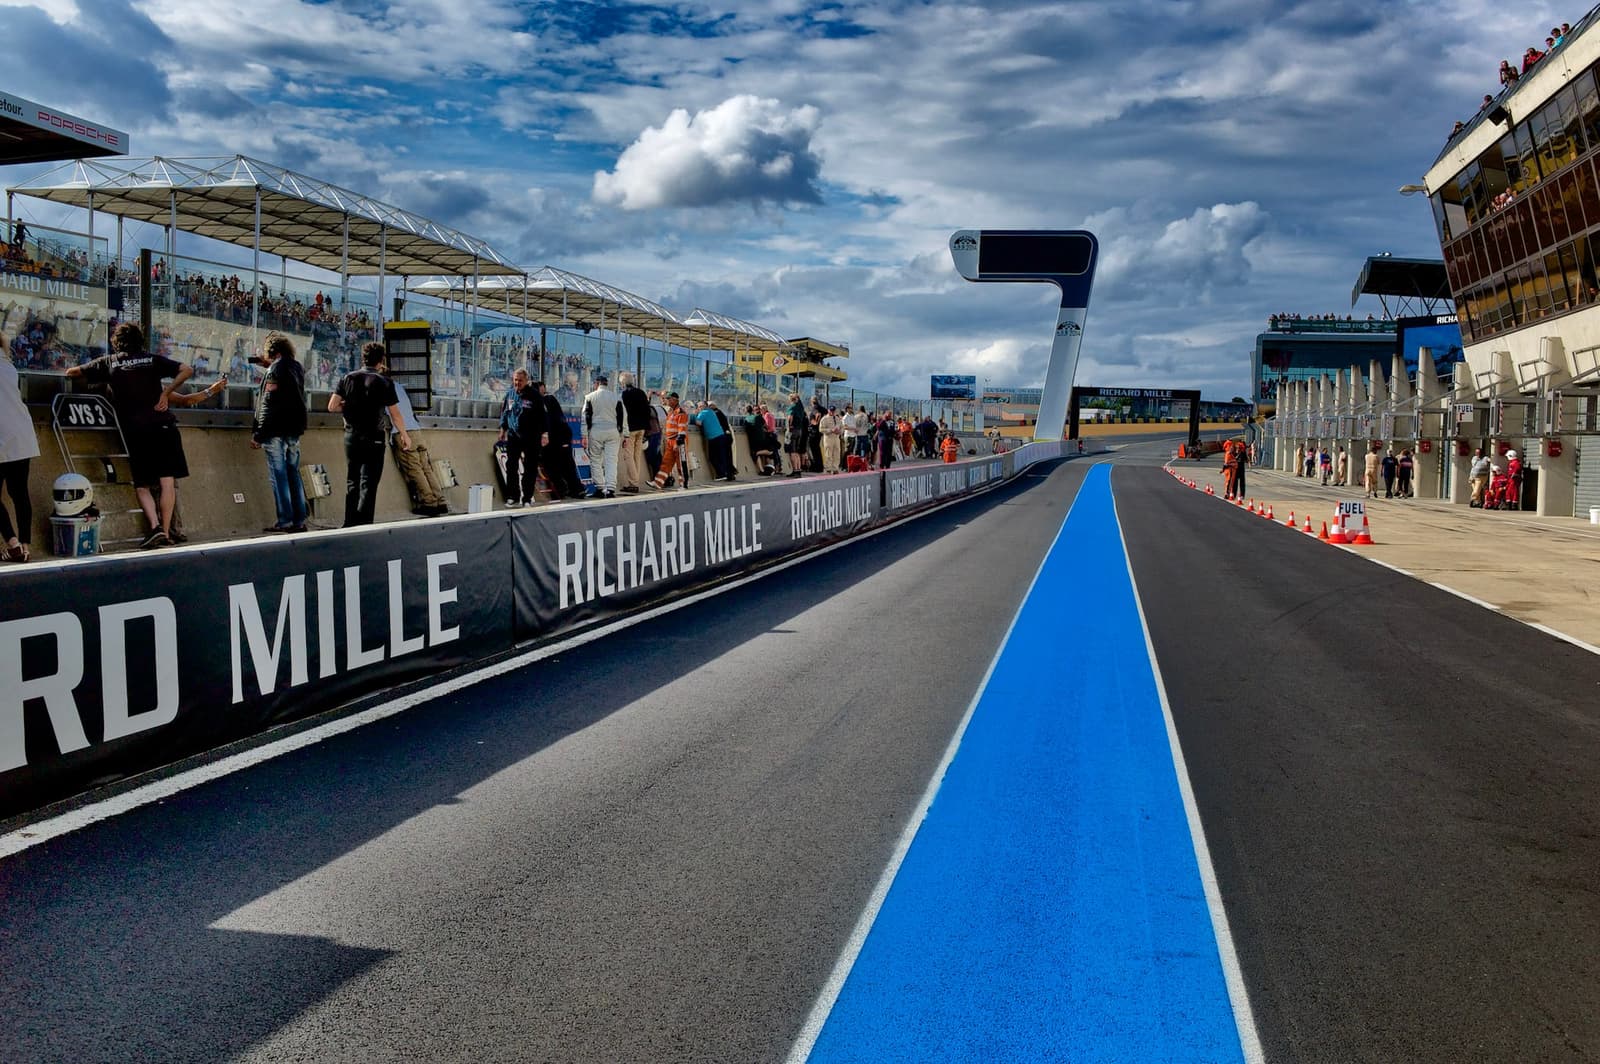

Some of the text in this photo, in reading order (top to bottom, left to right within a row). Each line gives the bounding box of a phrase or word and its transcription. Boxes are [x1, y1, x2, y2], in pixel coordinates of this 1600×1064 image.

[37, 111, 119, 146] PORSCHE
[46, 280, 89, 300] MILLE
[1100, 388, 1172, 398] RICHARD MILLE
[68, 403, 107, 425] JYS 3
[1457, 405, 1473, 413] FUEL
[891, 475, 918, 509] RICHARD
[918, 473, 933, 502] MILLE
[791, 484, 872, 540] RICHARD MILLE
[1339, 502, 1364, 515] FUEL
[557, 502, 763, 610] RICHARD MILLE
[228, 550, 460, 704] MILLE
